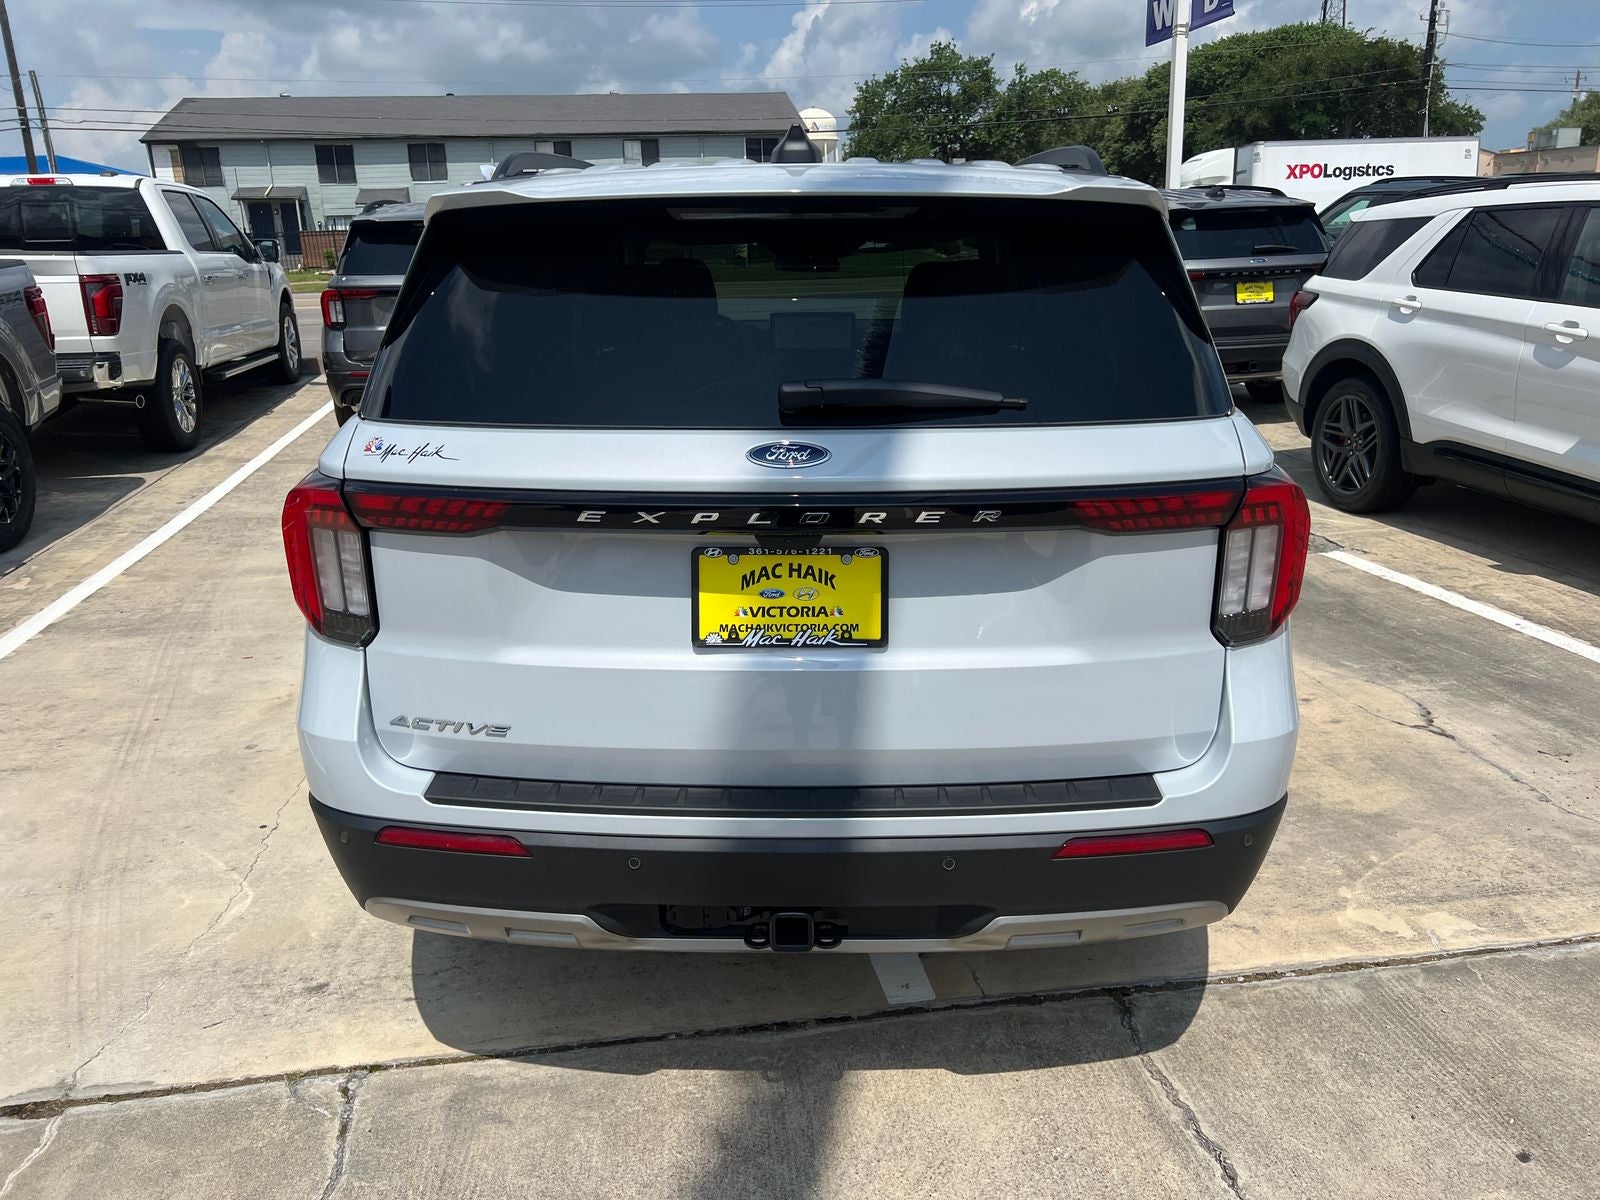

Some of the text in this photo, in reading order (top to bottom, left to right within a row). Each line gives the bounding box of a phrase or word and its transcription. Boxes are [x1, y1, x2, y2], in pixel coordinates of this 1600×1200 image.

[1286, 163, 1395, 180] XPO Logistics
[766, 445, 811, 460] Ford
[577, 510, 1001, 525] EXPLORER
[741, 563, 837, 591] MAC HAIK
[749, 606, 829, 618] VICTORIA
[719, 623, 860, 632] MACHAIKVICTORIACOM
[742, 628, 842, 648] Mac Haik
[389, 714, 512, 738] ACTIVE
